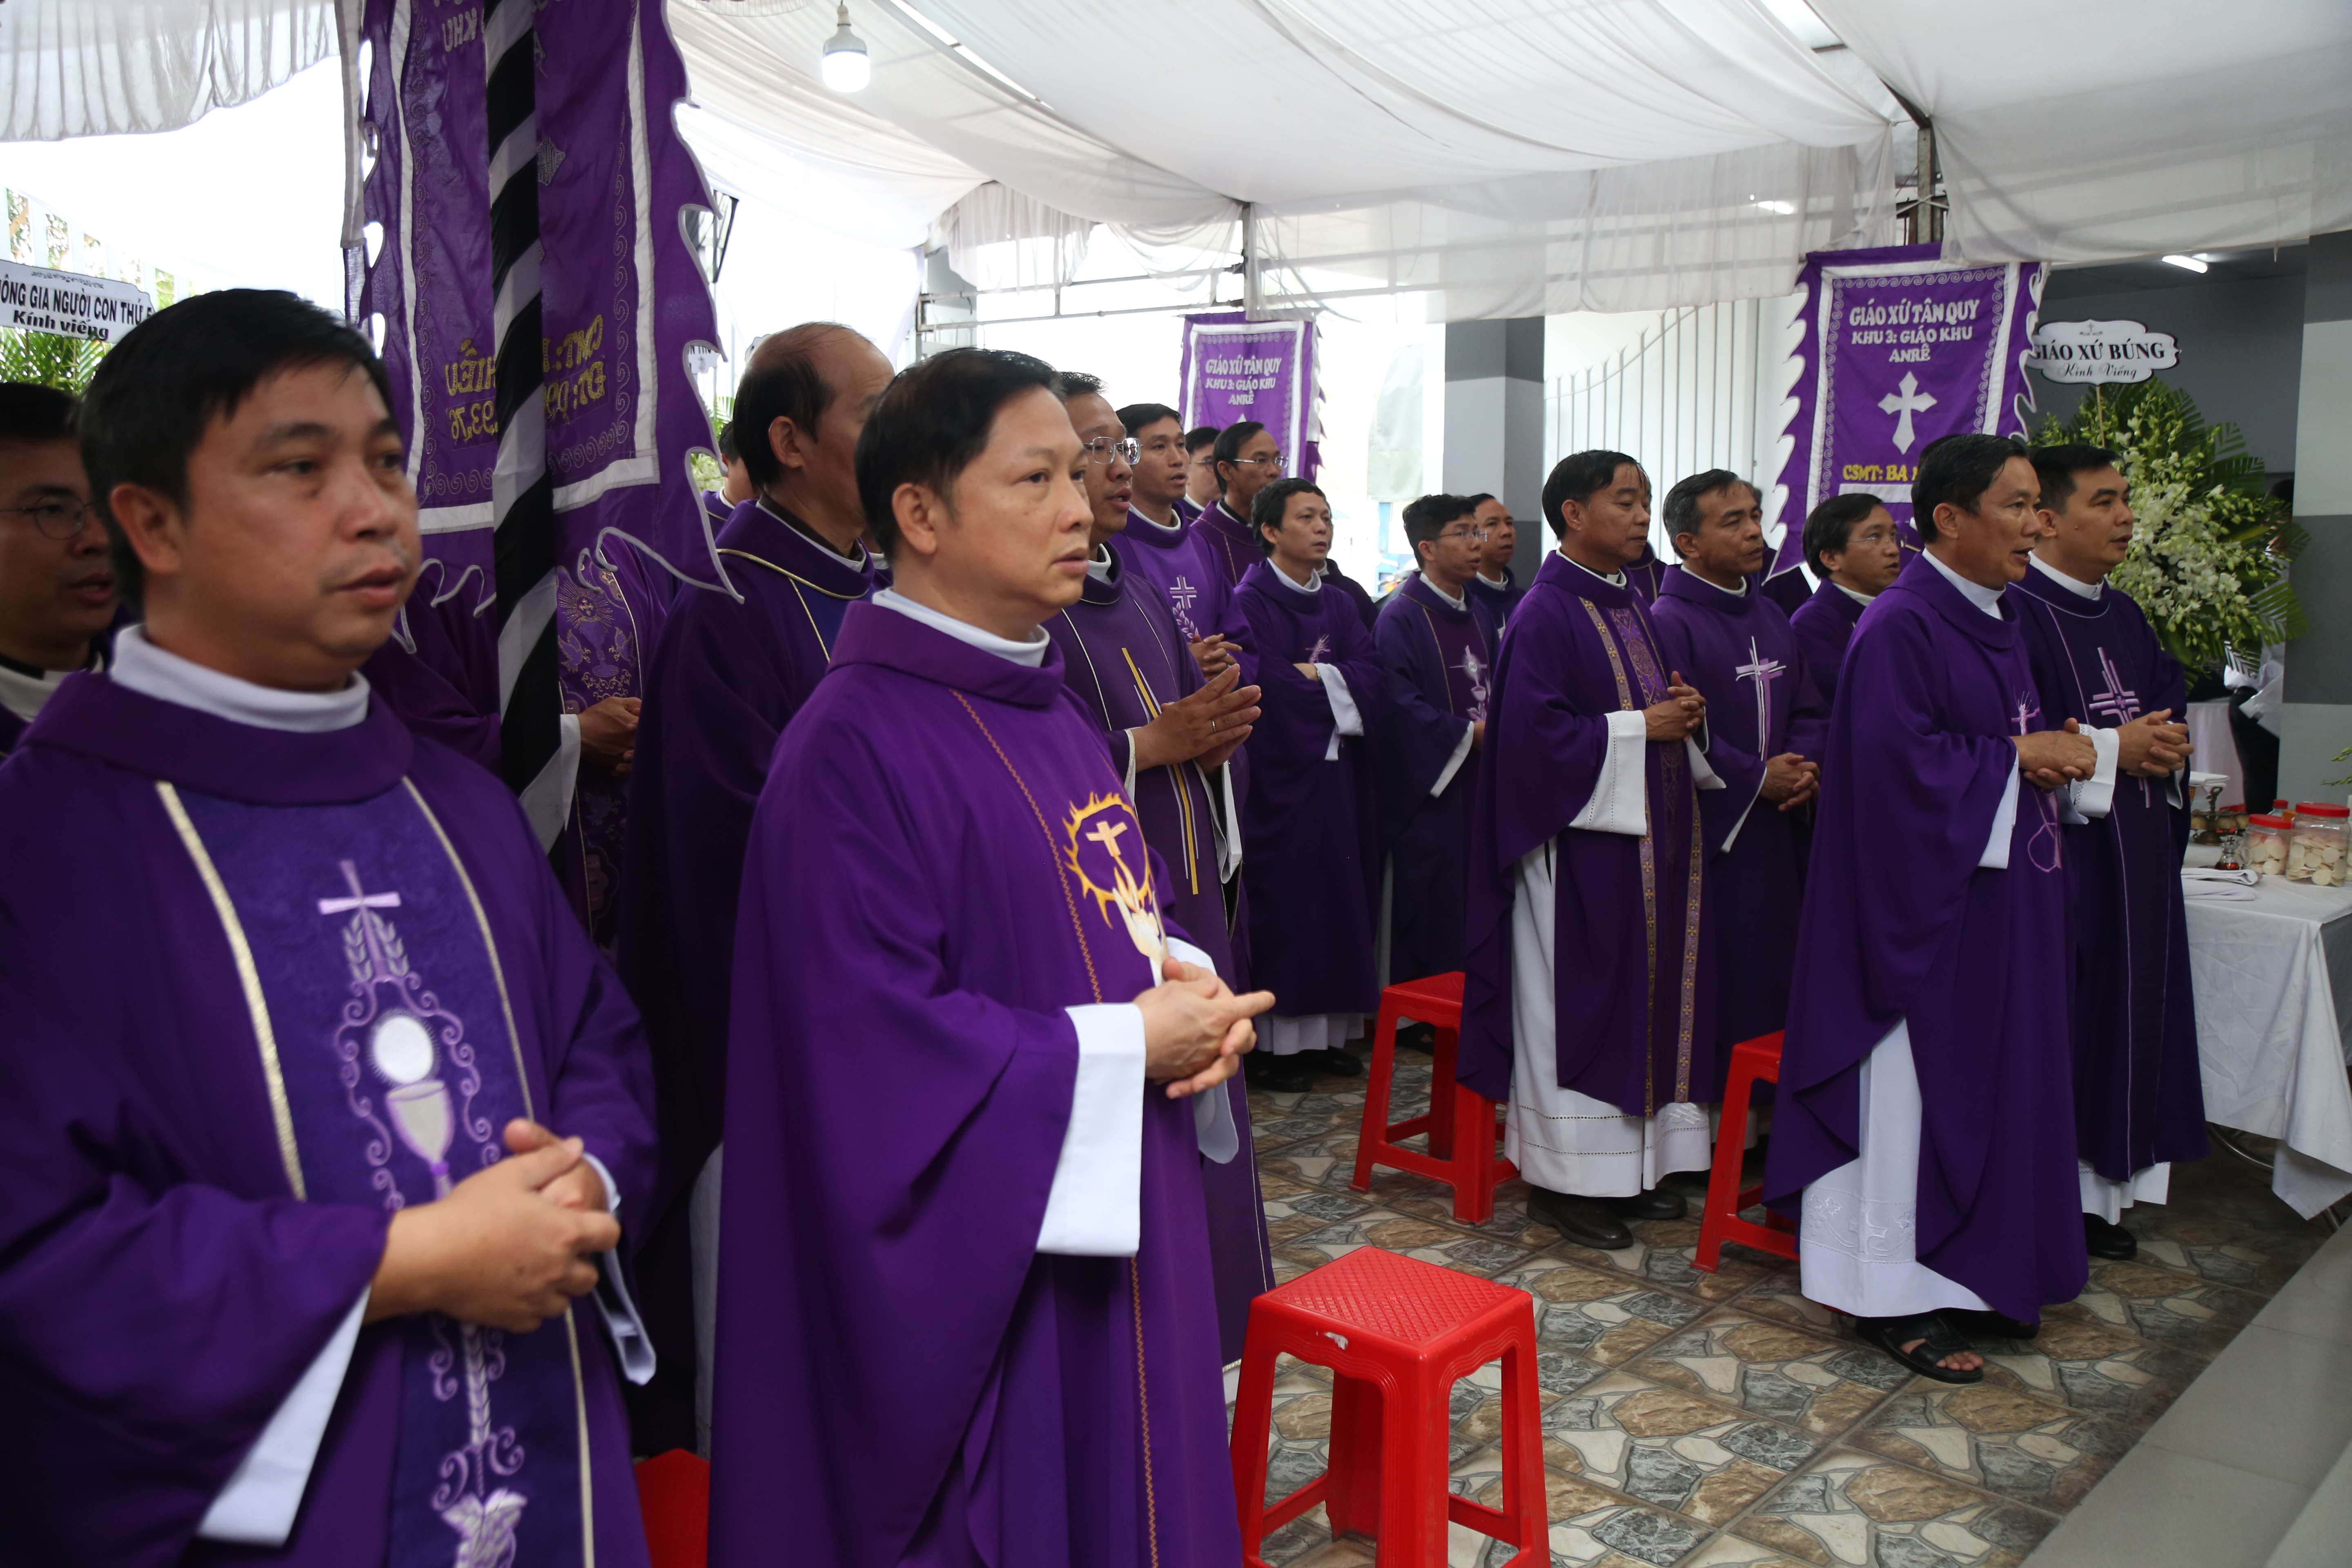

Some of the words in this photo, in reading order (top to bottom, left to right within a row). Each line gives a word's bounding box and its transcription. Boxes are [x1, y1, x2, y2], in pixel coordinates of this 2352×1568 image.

[0, 274, 26, 306] ÔNG
[30, 285, 49, 310] GIA
[53, 288, 91, 317] NGƯỜI
[94, 297, 117, 322] CON
[120, 298, 143, 326] THỨ
[1849, 298, 1886, 326] GIÁO
[1887, 298, 1911, 325] XỨ
[1912, 298, 1944, 324] TÂN
[1945, 299, 1980, 325] QUY
[13, 310, 56, 329] Kính
[60, 319, 109, 341] viếng
[1851, 330, 1883, 345] KHU
[1885, 329, 1897, 344] 3:
[1900, 325, 1937, 344] GIÁO
[1939, 326, 1973, 342] KHU
[1889, 343, 1931, 363] ANRÊ
[2077, 339, 2103, 360] XỨ
[2108, 338, 2164, 360] BÚNG
[1205, 354, 1228, 375] GIÁO
[1229, 354, 1243, 375] XỨ
[1243, 355, 1263, 375] TÂN
[1264, 358, 1282, 376] QUY
[1205, 378, 1227, 390] KHU
[1236, 376, 1258, 391] GIÁO
[1259, 378, 1276, 390] KHU
[1228, 390, 1254, 405] ANRÊ
[1886, 464, 1908, 482] BA
